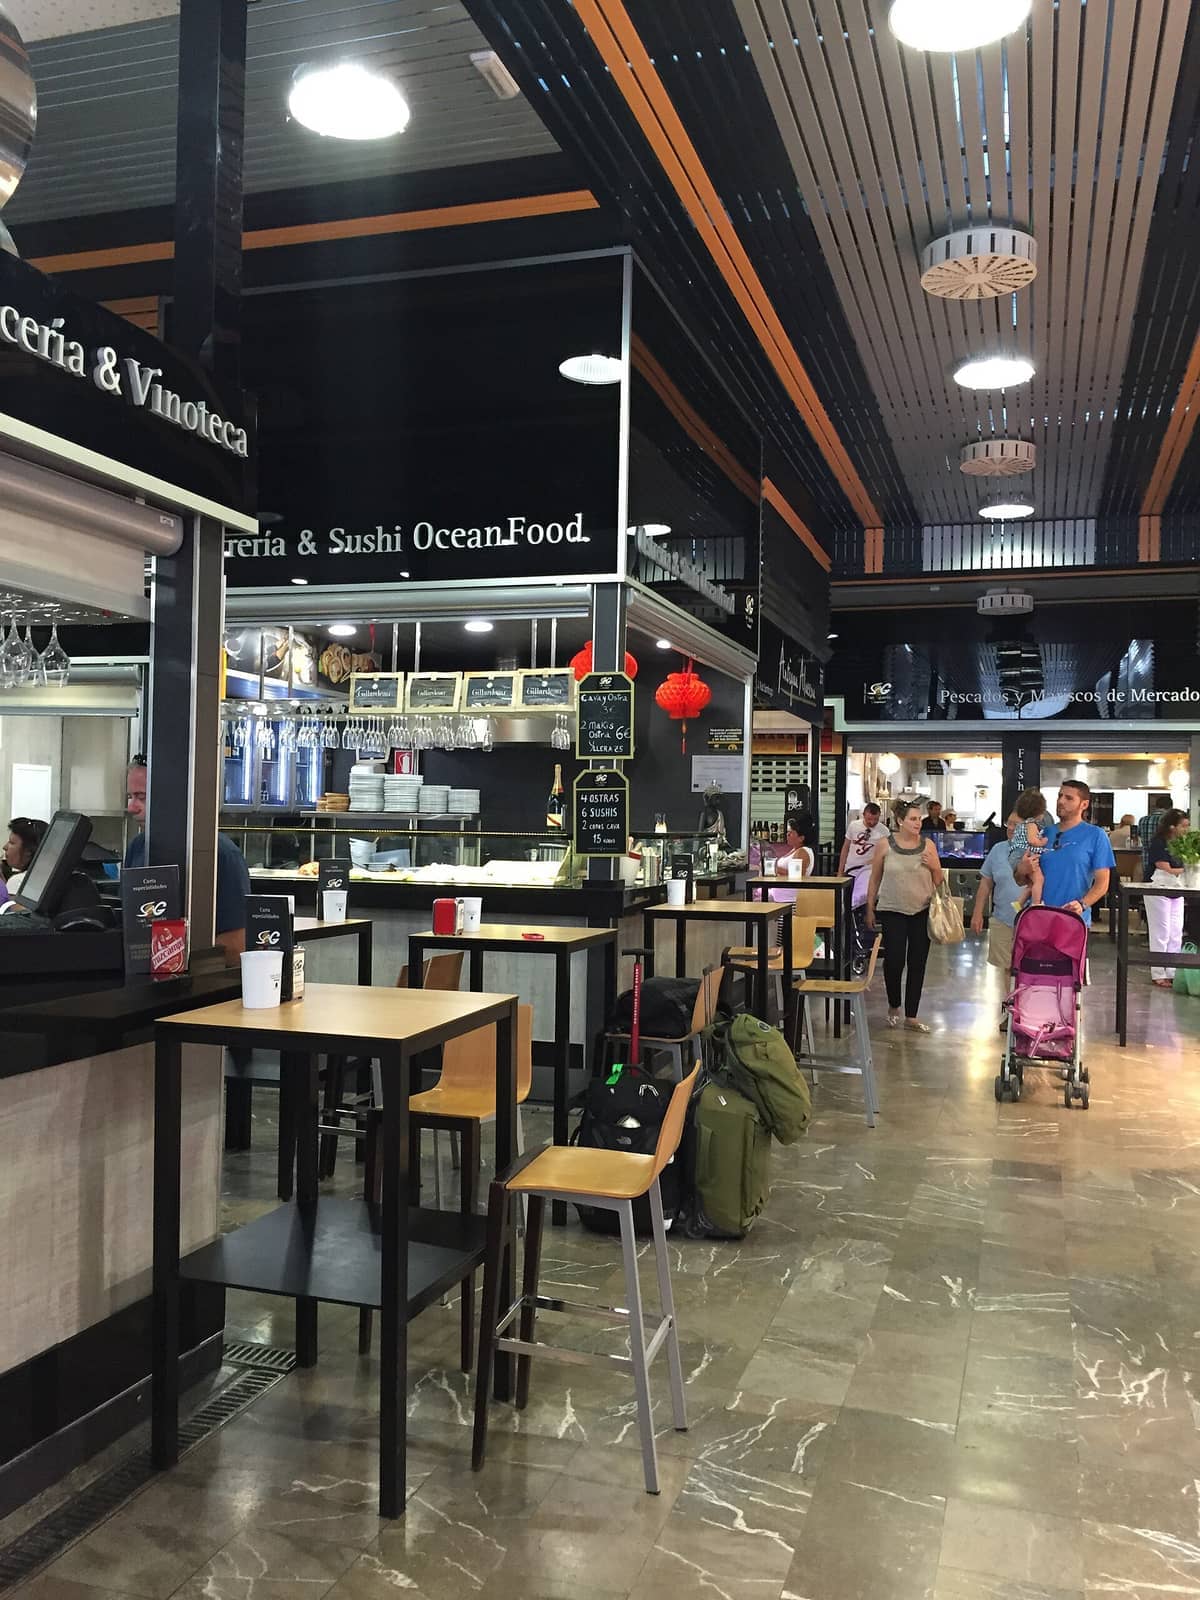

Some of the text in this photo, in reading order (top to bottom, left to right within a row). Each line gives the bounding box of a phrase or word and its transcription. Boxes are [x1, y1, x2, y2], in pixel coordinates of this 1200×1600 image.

[93, 346, 122, 396] &
[123, 358, 249, 458] Vinoteca
[297, 529, 318, 556] &
[328, 525, 402, 554] Sushi
[940, 690, 1009, 704] Pescados
[1014, 693, 1024, 705] y
[1107, 688, 1126, 702] de
[1131, 687, 1200, 702] Mercado
[580, 720, 586, 730] 2
[580, 794, 620, 803] 4 OSTRAS
[582, 808, 618, 818] 6 SUSHIS
[582, 820, 587, 830] 2
[594, 834, 602, 844] 15
